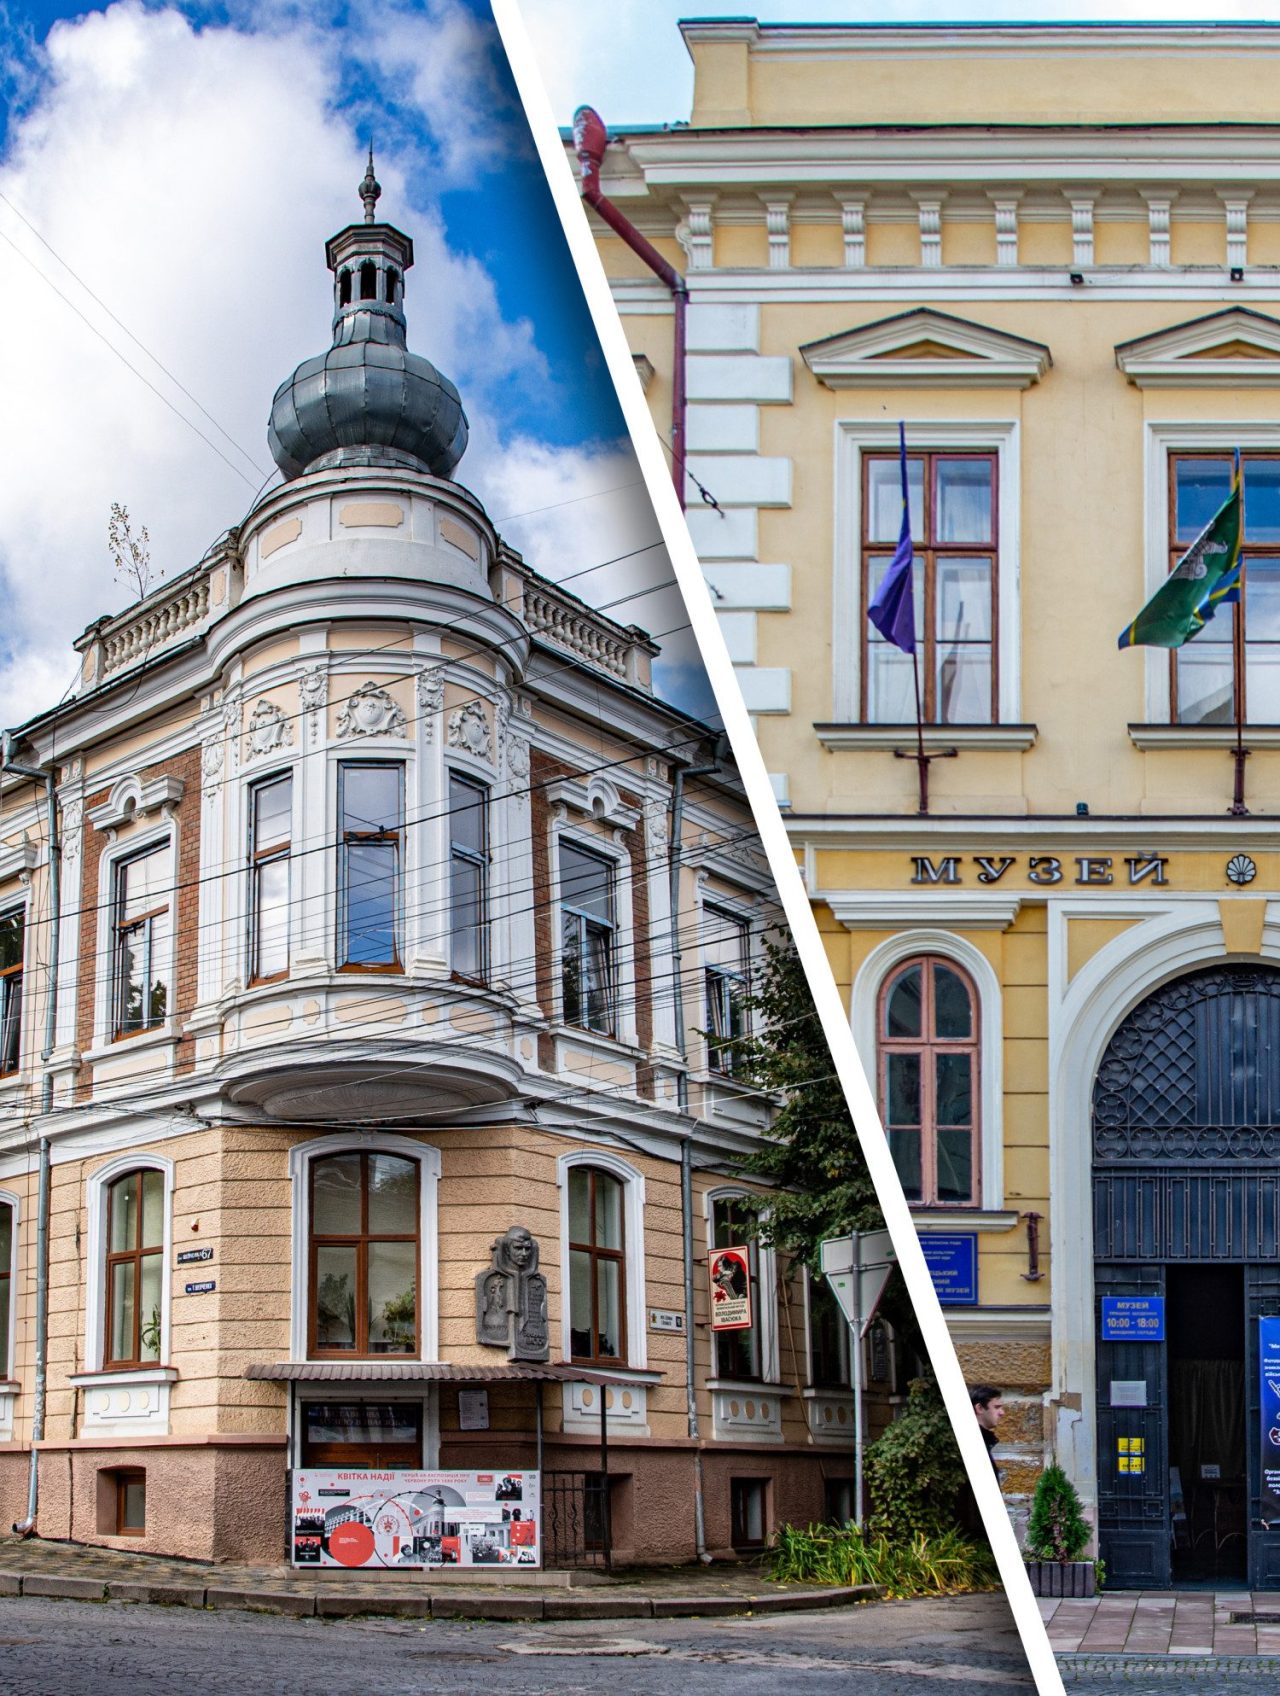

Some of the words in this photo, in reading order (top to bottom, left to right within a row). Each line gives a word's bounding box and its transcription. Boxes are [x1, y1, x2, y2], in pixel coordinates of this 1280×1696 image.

[911, 851, 1169, 885] МУЗЕЙ
[201, 1248, 212, 1259] 67
[1107, 1318, 1130, 1328] 10:00
[1137, 1318, 1159, 1328] 18:00
[337, 1472, 369, 1481] КВІТКА
[370, 1472, 395, 1482] НАДІЇ
